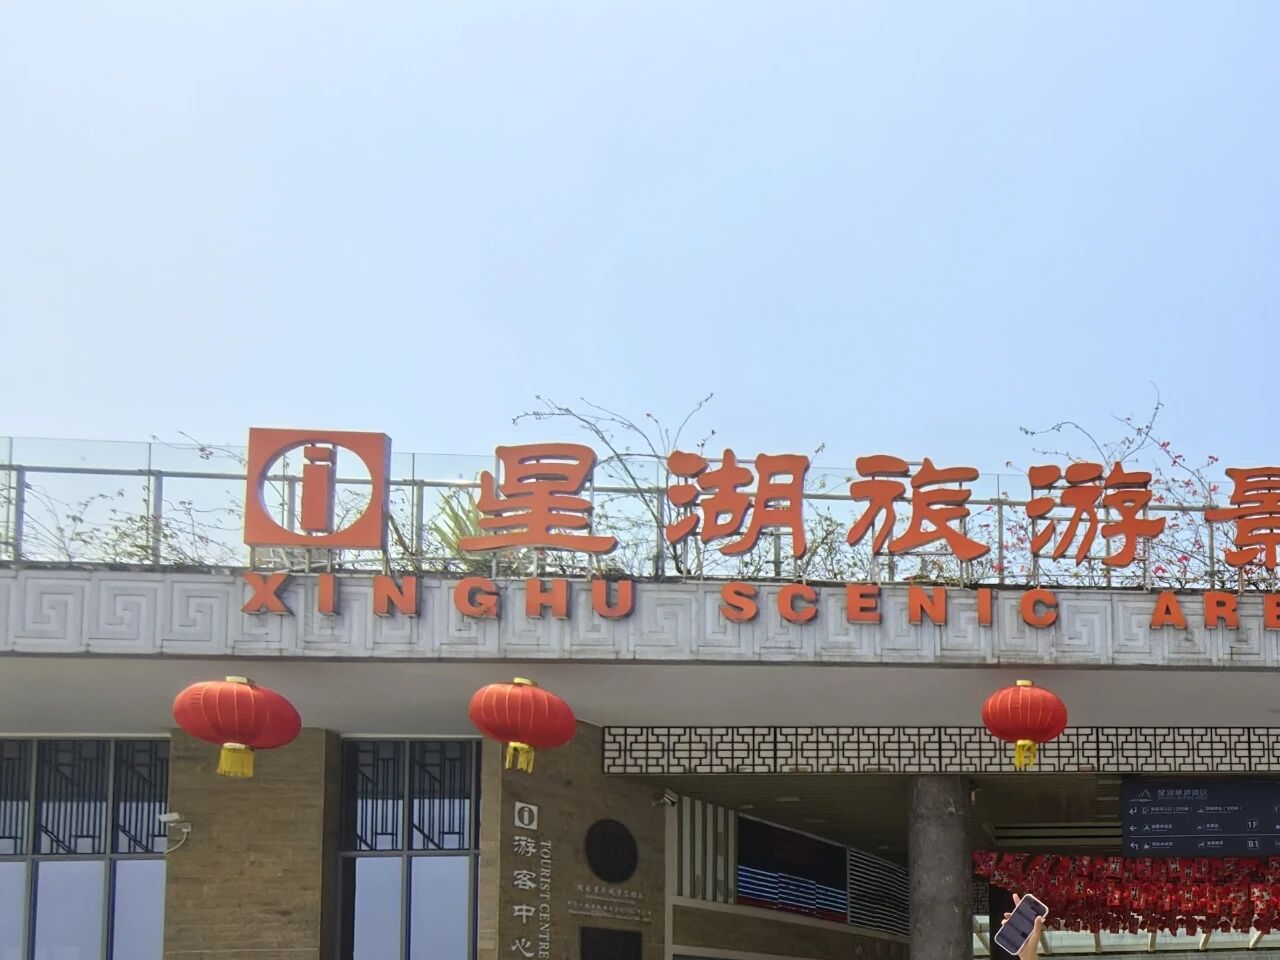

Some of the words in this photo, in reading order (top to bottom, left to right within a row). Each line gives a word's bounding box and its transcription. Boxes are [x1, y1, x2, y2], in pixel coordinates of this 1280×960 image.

[241, 571, 636, 620] XINGHU
[719, 582, 1060, 629] SCENIC
[511, 835, 537, 958] 游客中心
[539, 840, 551, 901] TOURIST
[538, 904, 550, 960] CENTRE
